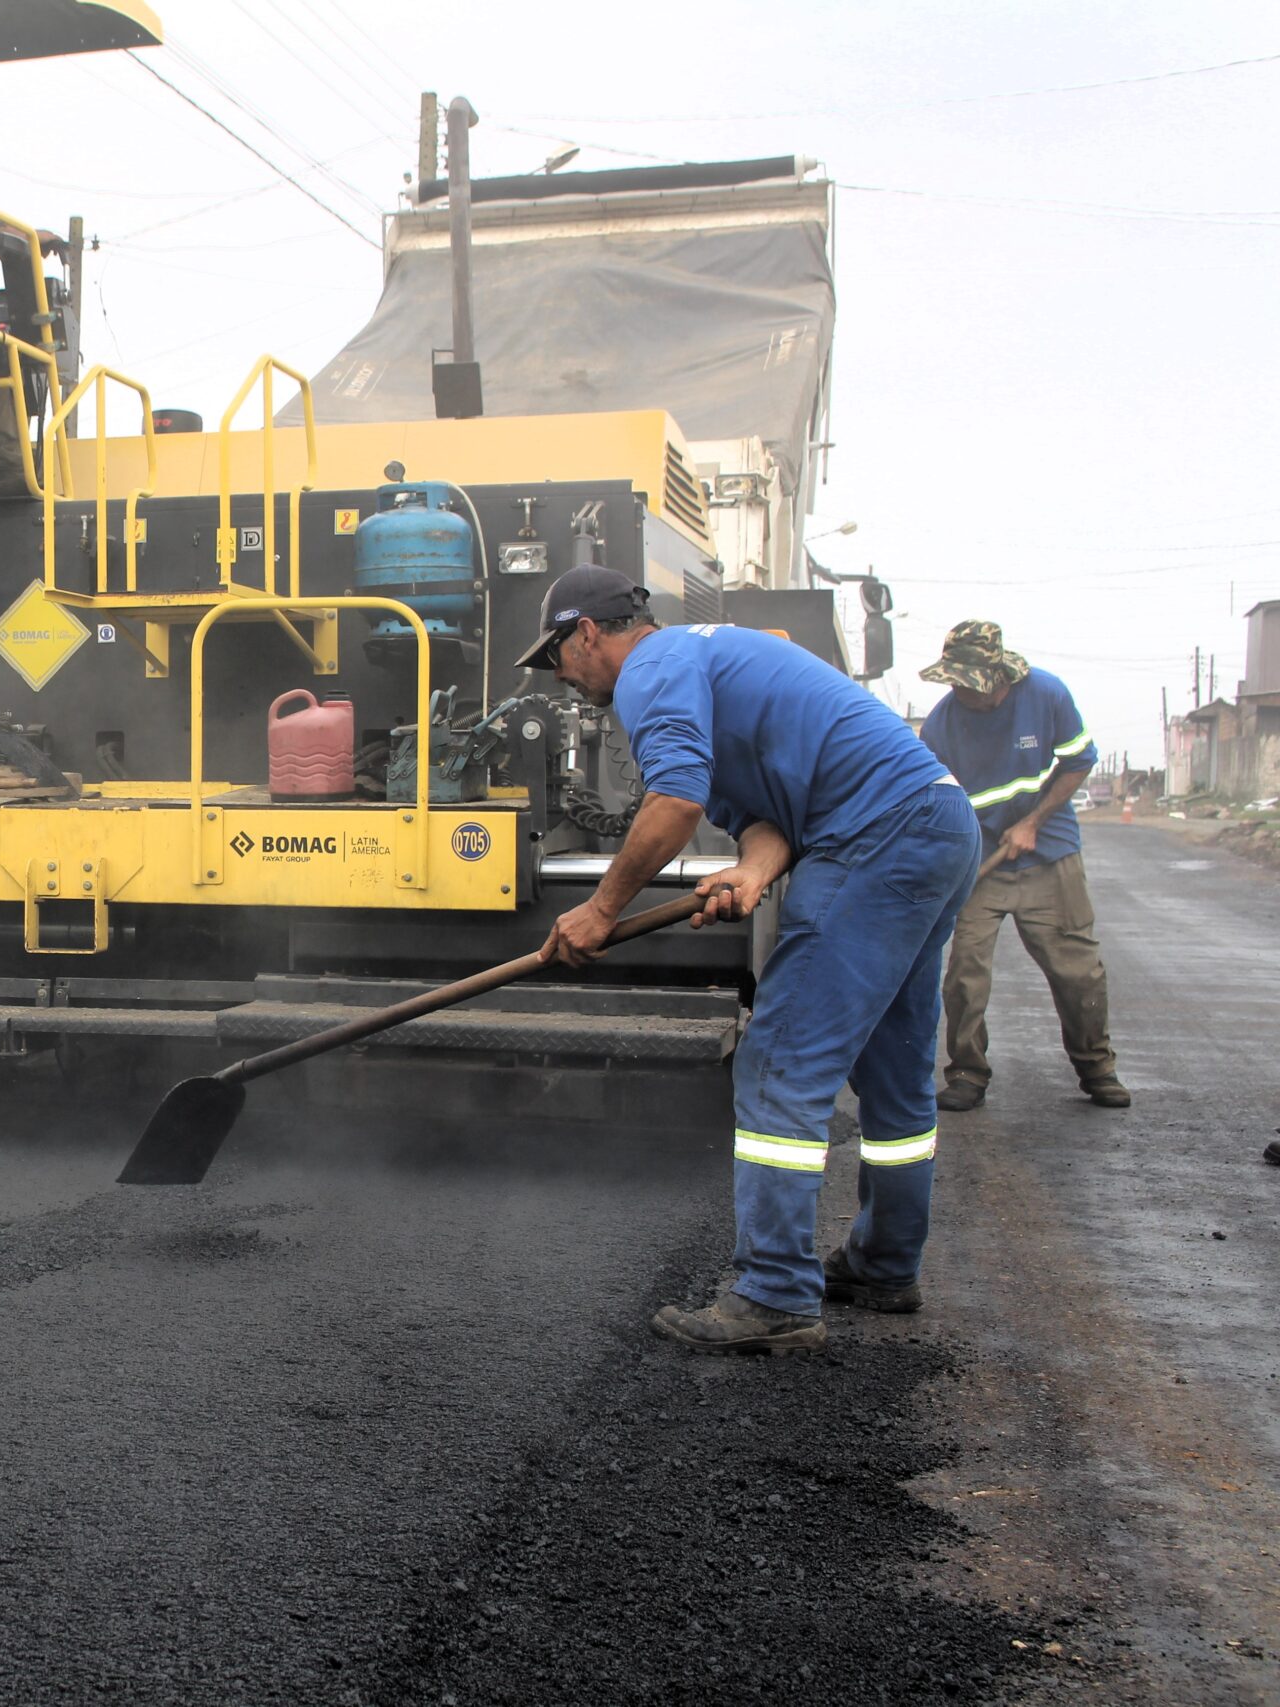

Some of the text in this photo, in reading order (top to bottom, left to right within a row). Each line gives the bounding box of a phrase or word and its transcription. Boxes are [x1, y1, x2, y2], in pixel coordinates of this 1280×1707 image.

[13, 631, 50, 640] BOMAG
[262, 836, 337, 854] BOMAG
[351, 837, 379, 846] LATIN
[456, 831, 485, 853] 0705
[351, 846, 391, 855] AMERICA
[286, 855, 311, 863] GROUP
